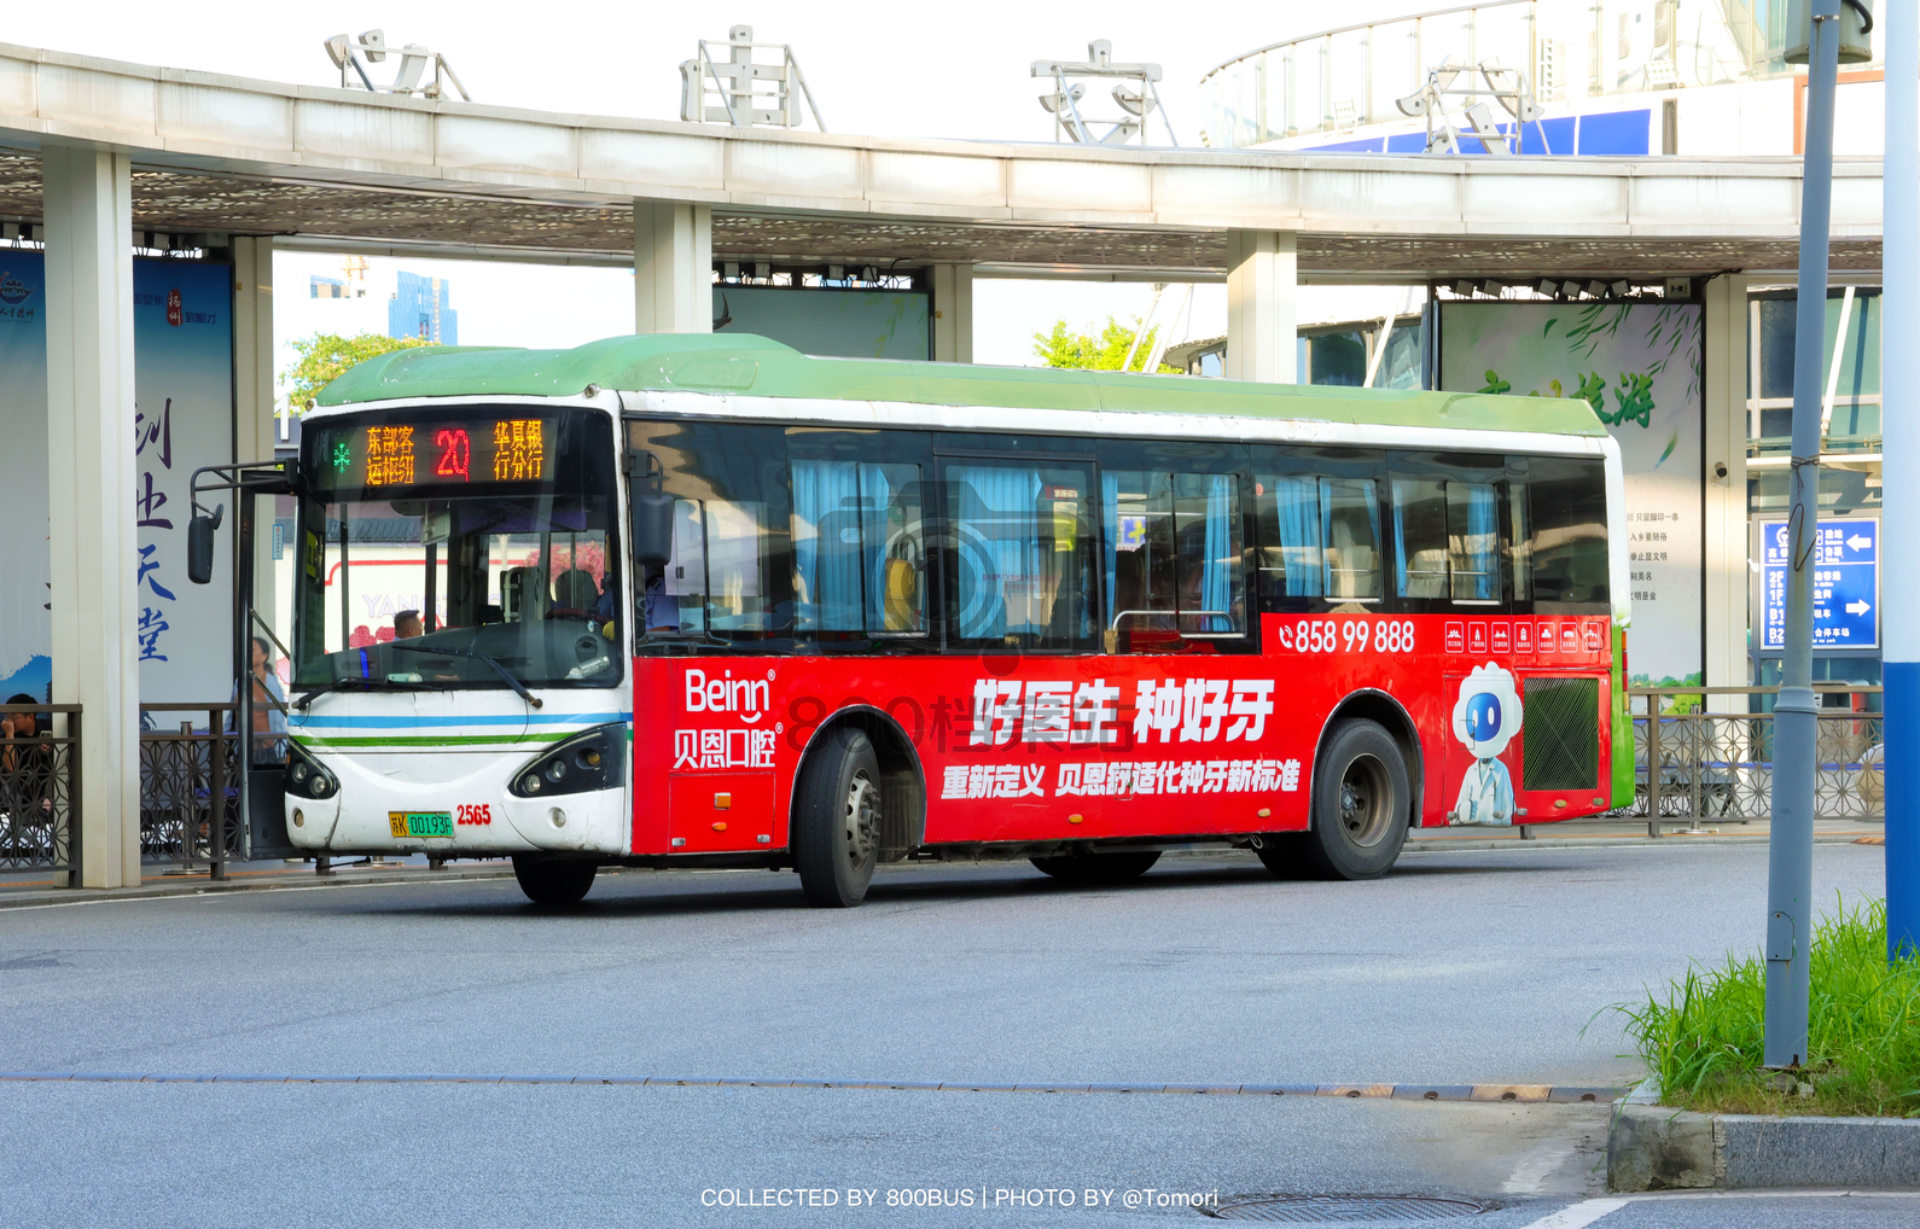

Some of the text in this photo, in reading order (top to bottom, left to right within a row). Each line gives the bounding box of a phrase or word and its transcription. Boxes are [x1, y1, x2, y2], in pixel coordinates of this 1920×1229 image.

[366, 426, 415, 456] 东部客
[493, 419, 543, 451] 华夏银
[436, 429, 470, 482] 20
[493, 450, 543, 481] 行分行
[366, 455, 415, 485] 运枢纽
[1635, 512, 1679, 522] 只留脚印一串
[1630, 532, 1668, 542] 入乡要随俗
[1630, 552, 1668, 561] 举止显文明
[1769, 571, 1784, 582] 2F
[1769, 589, 1784, 600] 1F
[1769, 608, 1784, 620] B1
[1296, 620, 1415, 652] 858 99 888
[1769, 628, 1785, 640] B2
[969, 679, 1275, 746] 好医生 种好牙
[941, 758, 1301, 800] 重新定义 贝恩舒适化种牙新标准
[457, 804, 491, 826] 2565
